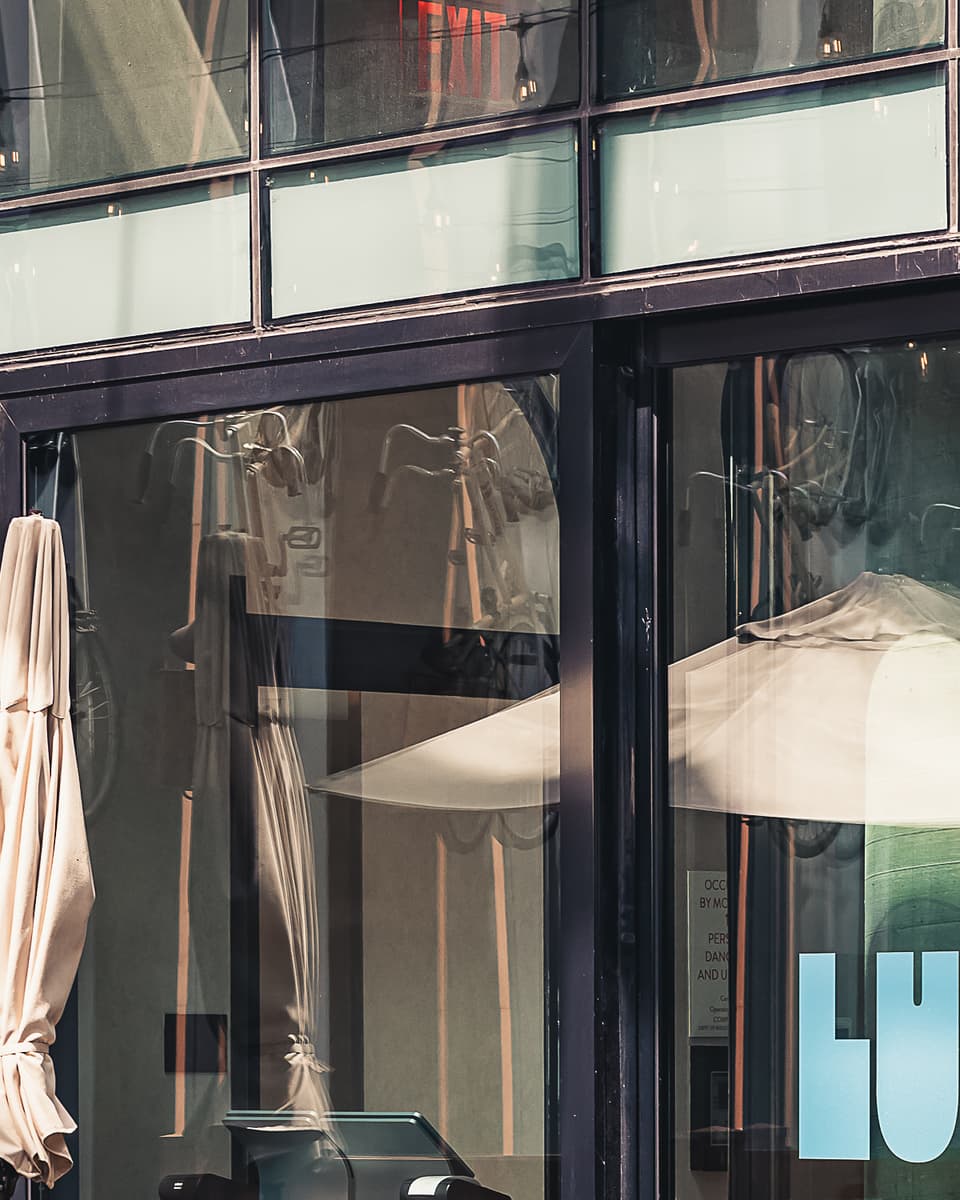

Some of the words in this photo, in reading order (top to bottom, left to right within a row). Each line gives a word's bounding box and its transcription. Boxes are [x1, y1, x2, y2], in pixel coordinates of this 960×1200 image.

[417, 1, 507, 100] EXIT
[699, 897, 711, 909] BY
[697, 968, 719, 981] AND
